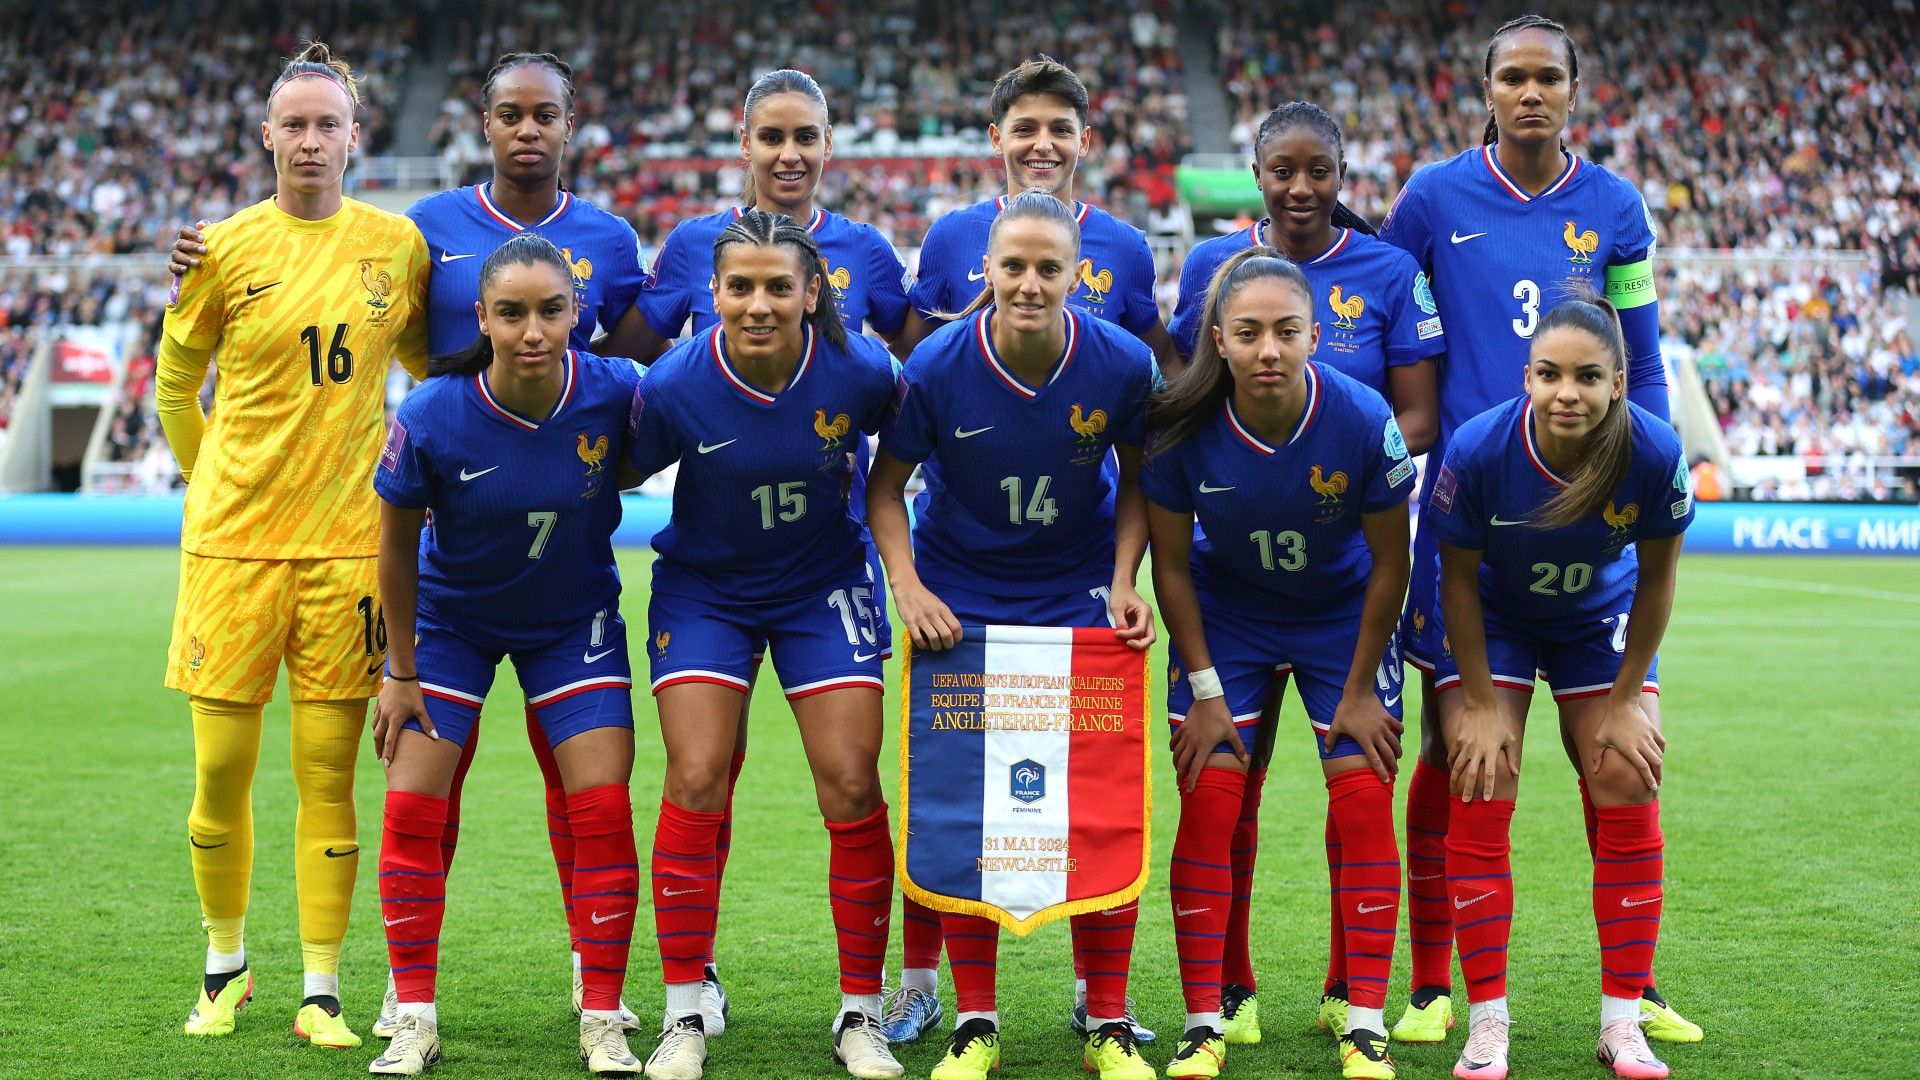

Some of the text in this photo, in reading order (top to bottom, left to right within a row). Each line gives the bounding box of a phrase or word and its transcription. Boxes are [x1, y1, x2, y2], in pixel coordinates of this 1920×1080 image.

[1512, 279, 1541, 339] 3
[300, 323, 354, 387] 16
[751, 481, 807, 530] 15
[1000, 475, 1059, 526] 14
[527, 511, 558, 559] 7
[1249, 530, 1308, 572] 13
[1732, 515, 1830, 549] PEACE
[1529, 562, 1593, 595] 20
[827, 588, 878, 646] 15
[932, 673, 1125, 691] UEFA WOMEN'S EUROPEAN QUALIFIERS
[931, 693, 1123, 710] EQUIPE DE FRANCE FEMININE
[930, 711, 1124, 732] ANGLETERRE-FRANCE
[984, 836, 1070, 852] 31 MAI 2024
[976, 857, 1077, 872] NEWCASTLE
